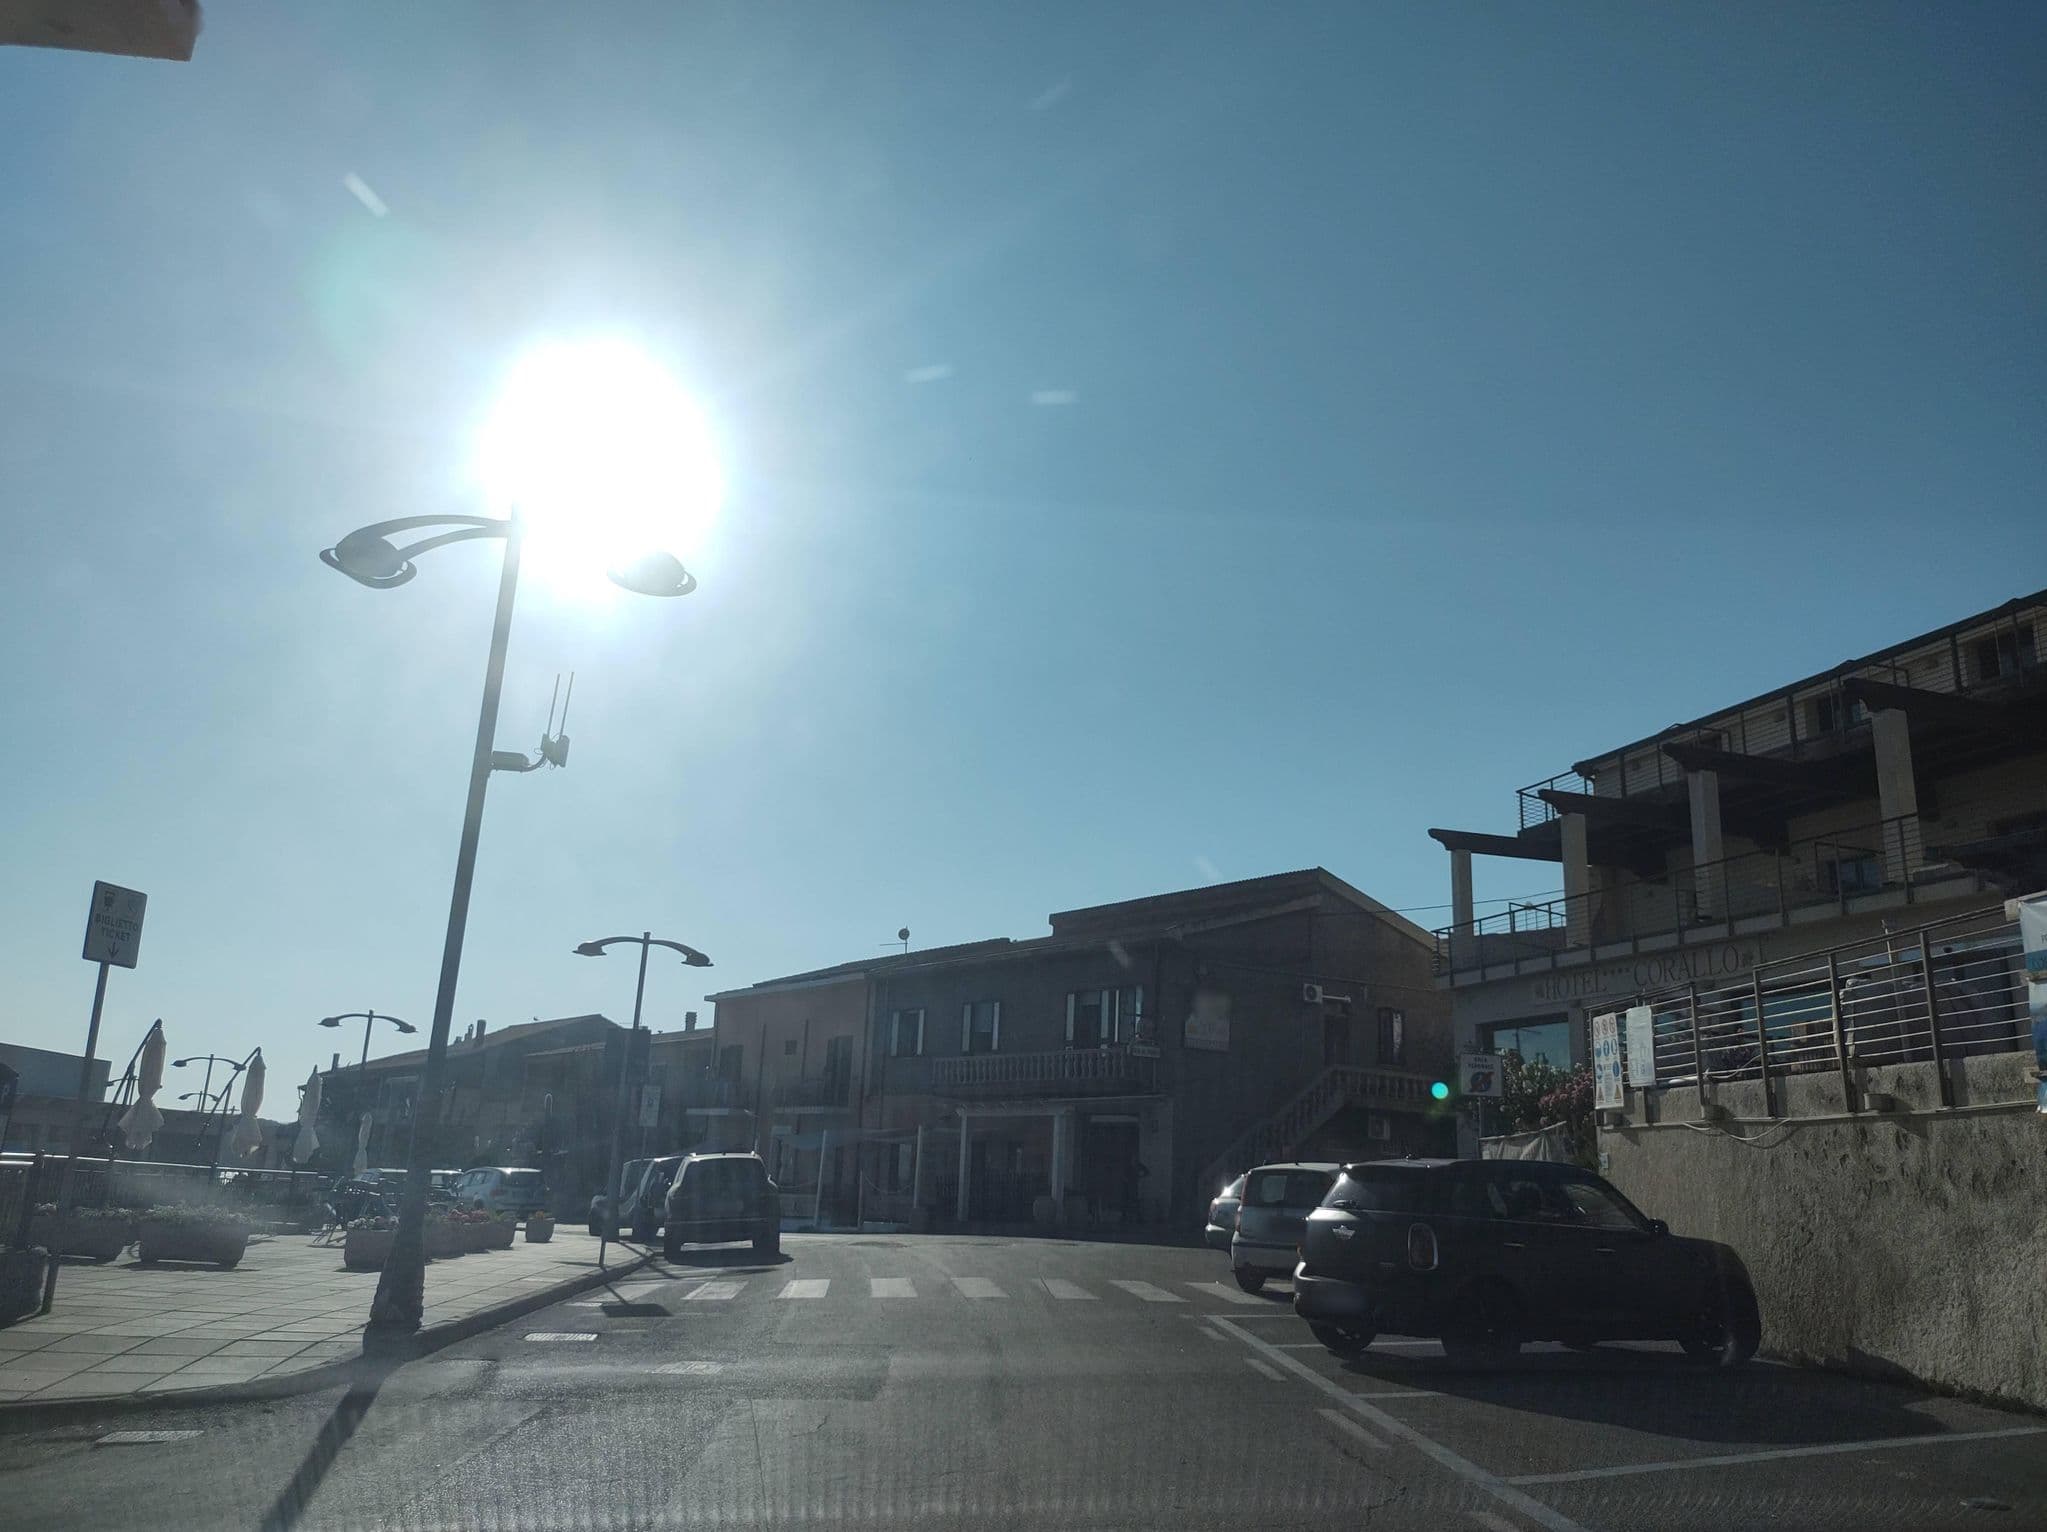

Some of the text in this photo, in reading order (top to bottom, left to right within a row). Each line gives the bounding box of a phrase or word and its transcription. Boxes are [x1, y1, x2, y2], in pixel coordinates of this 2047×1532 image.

[95, 912, 138, 931] BIGLIETTO
[101, 927, 132, 942] TICKET
[1544, 969, 1608, 1000] HOTEL
[1633, 943, 1740, 987] CORALLO
